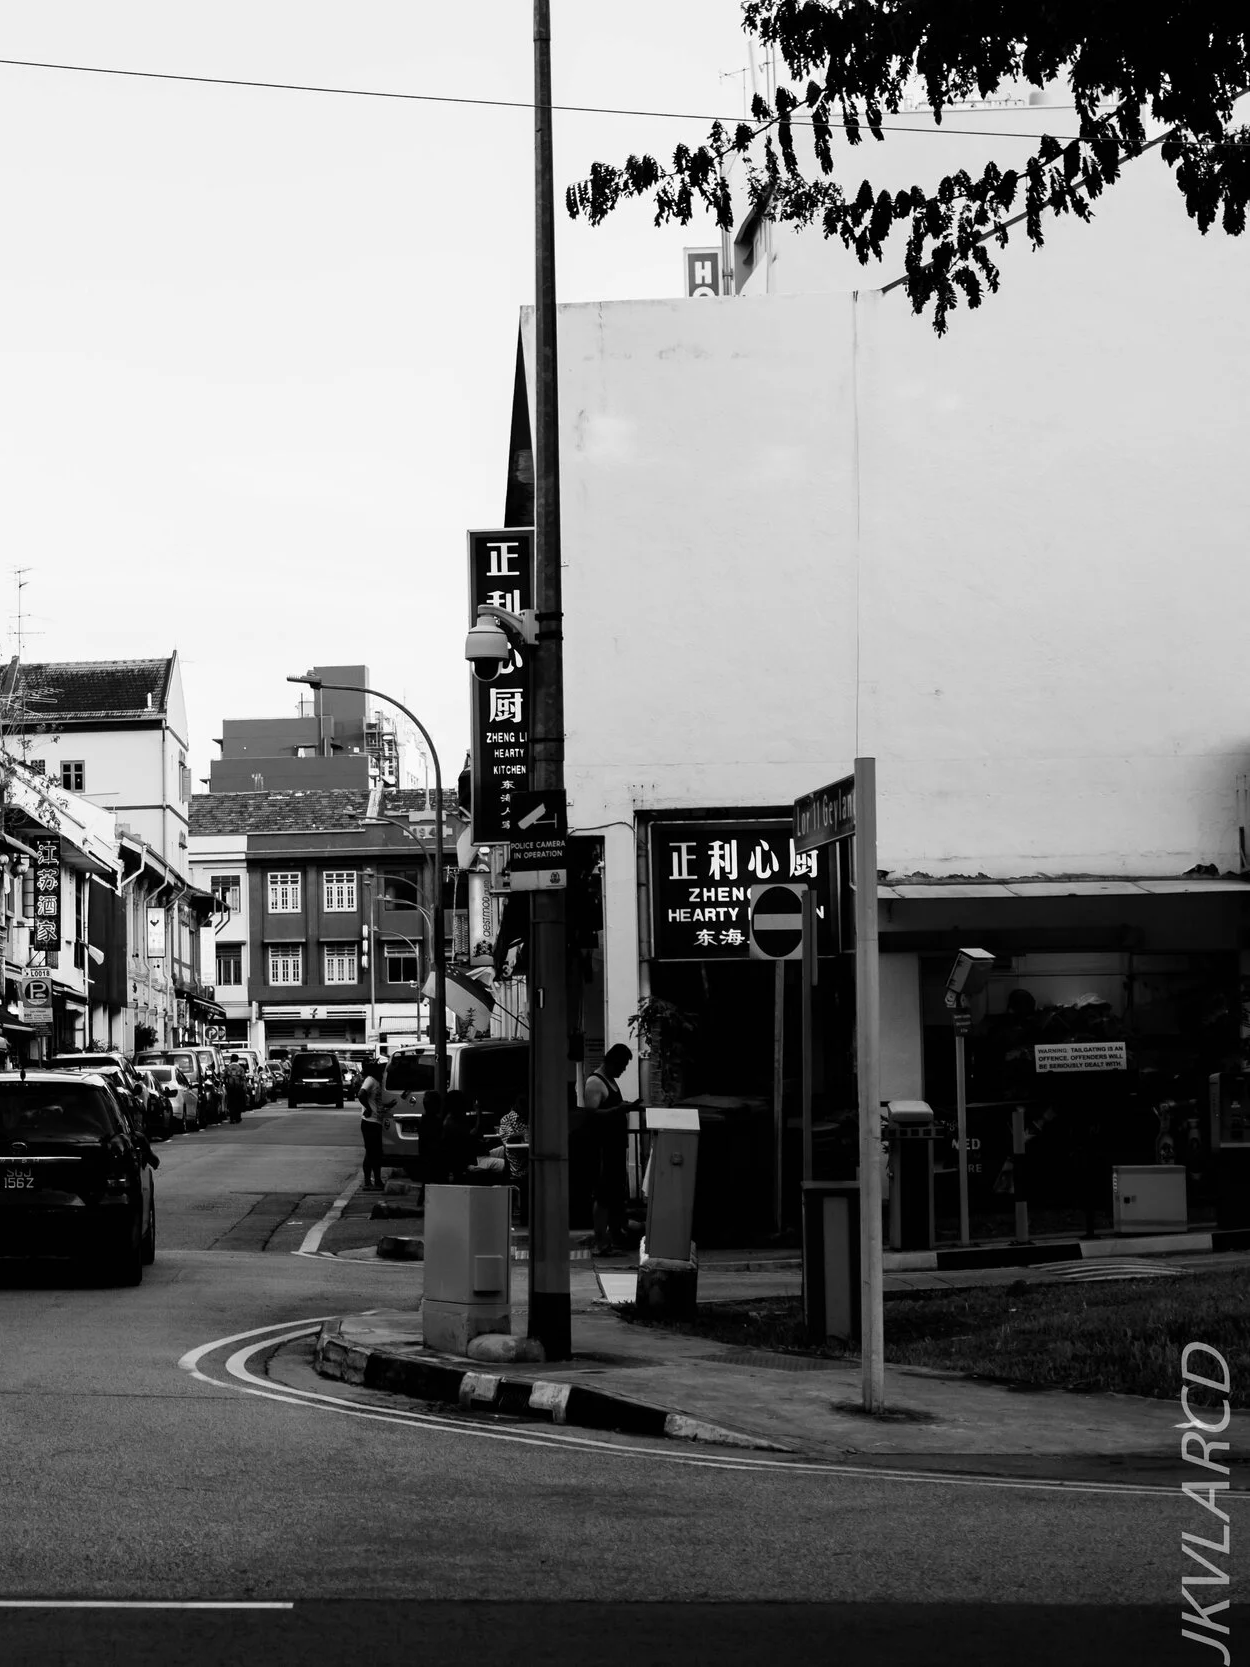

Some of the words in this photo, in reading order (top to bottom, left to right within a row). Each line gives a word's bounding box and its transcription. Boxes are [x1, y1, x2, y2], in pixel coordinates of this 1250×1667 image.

[486, 732, 516, 743] ZHENG
[519, 732, 528, 742] LI
[494, 749, 525, 758] HEARTY
[493, 765, 527, 775] KITCHEN
[823, 788, 855, 832] Geylan
[511, 841, 534, 850] POLICE
[536, 840, 567, 849] CAMERA
[513, 852, 521, 860] IN
[523, 850, 563, 859] OPERATION
[668, 838, 818, 881] 正利心厨
[36, 844, 60, 942] 江苏酒家
[668, 907, 740, 923] HEARTY
[693, 929, 750, 947] 东海
[30, 982, 47, 999] P
